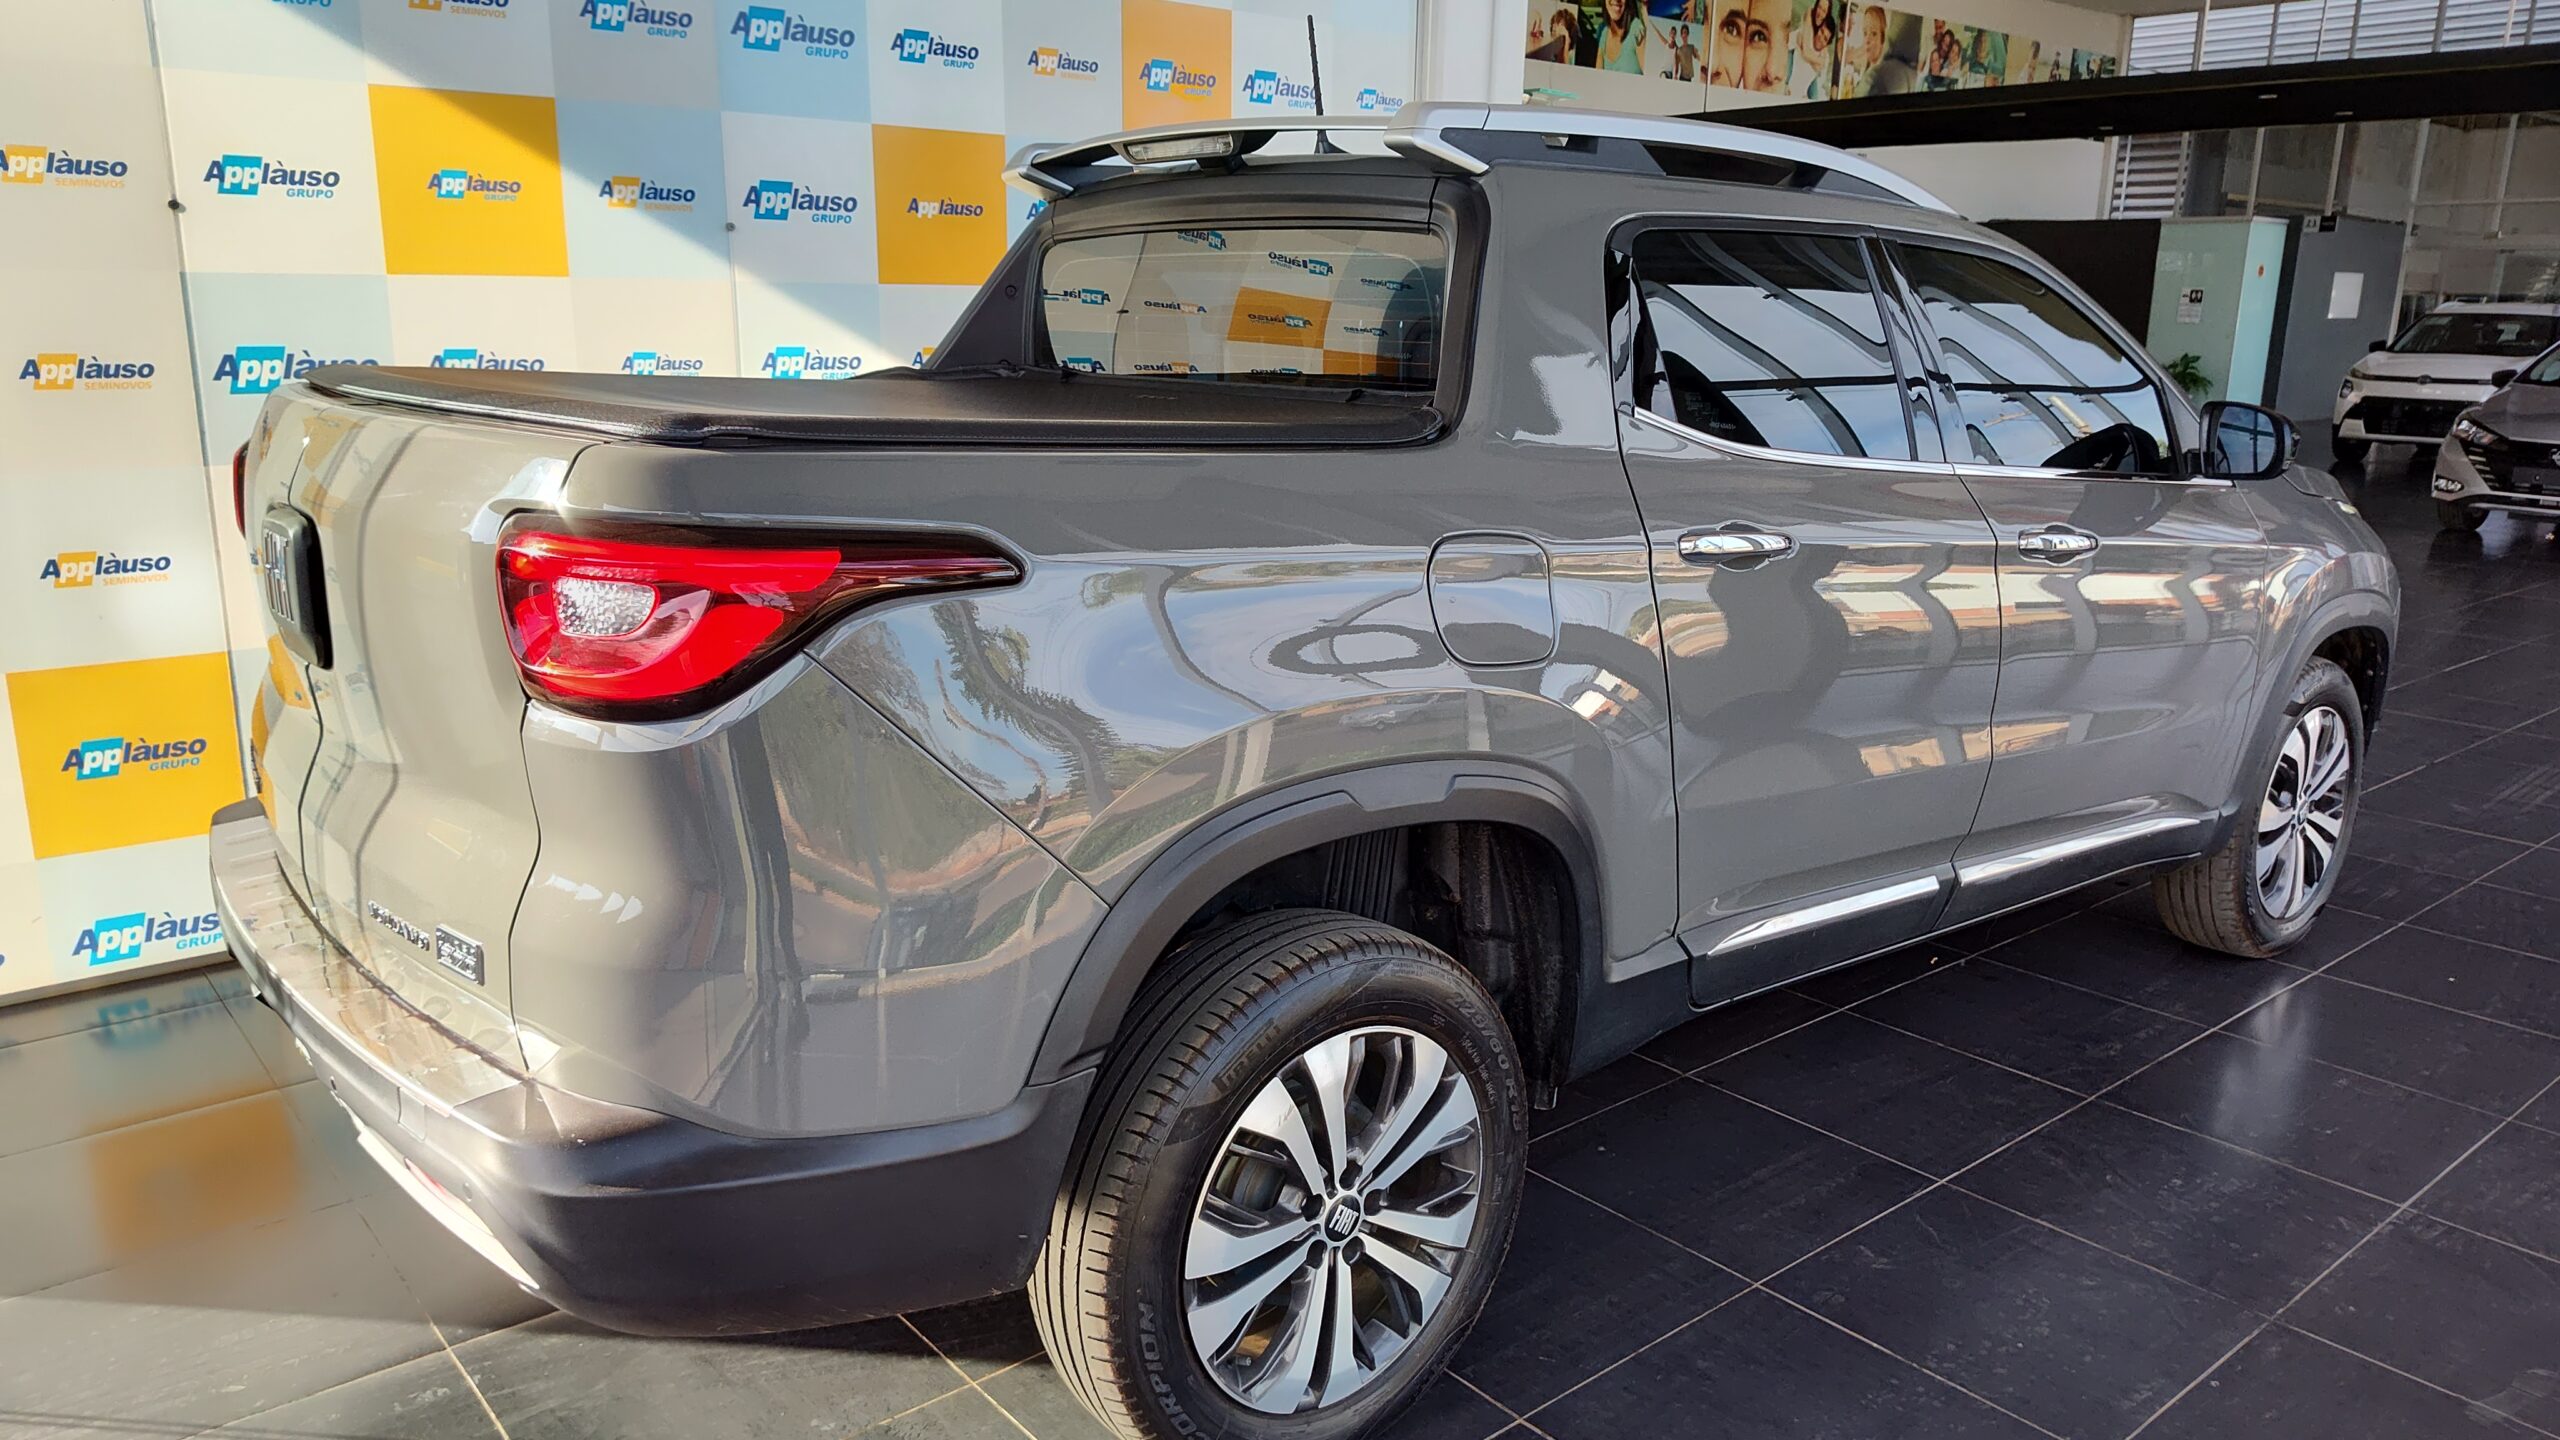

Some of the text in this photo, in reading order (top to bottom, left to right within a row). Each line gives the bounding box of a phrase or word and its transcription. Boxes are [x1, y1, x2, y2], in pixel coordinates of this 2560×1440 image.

[449, 5, 507, 18] SEMINOVOS
[647, 26, 688, 39] GRUPO
[730, 10, 856, 48] Applàuso
[805, 46, 849, 60] GRUPO
[890, 33, 980, 61] Applàuso
[943, 58, 975, 70] GRUPO
[1027, 50, 1099, 74] Applàuso
[1139, 62, 1217, 88] Applàuso
[1355, 90, 1403, 108] Applàuso
[54, 177, 126, 189] SEMINOVOS
[203, 159, 341, 191] Applàuso
[427, 173, 522, 196] Applàuso
[286, 188, 335, 199] GRUPO
[484, 193, 518, 202] GRUPO
[599, 180, 696, 205] Applàuso
[742, 186, 858, 216] Applàuso
[811, 213, 853, 224] GRUPO
[906, 197, 984, 218] Applàuso
[19, 355, 155, 386] Applàuso
[621, 354, 704, 376] Applàuso
[761, 349, 862, 377] Applàuso
[84, 381, 153, 391] SEMINOVOS
[40, 552, 171, 584] Applàuso
[102, 572, 169, 587] SEMINOVOS
[61, 737, 207, 776] Applàuso
[149, 756, 201, 772] GRUPO
[72, 911, 221, 959] Applàus
[176, 931, 224, 950] GRUP
[1328, 1204, 1360, 1236] FIAT
